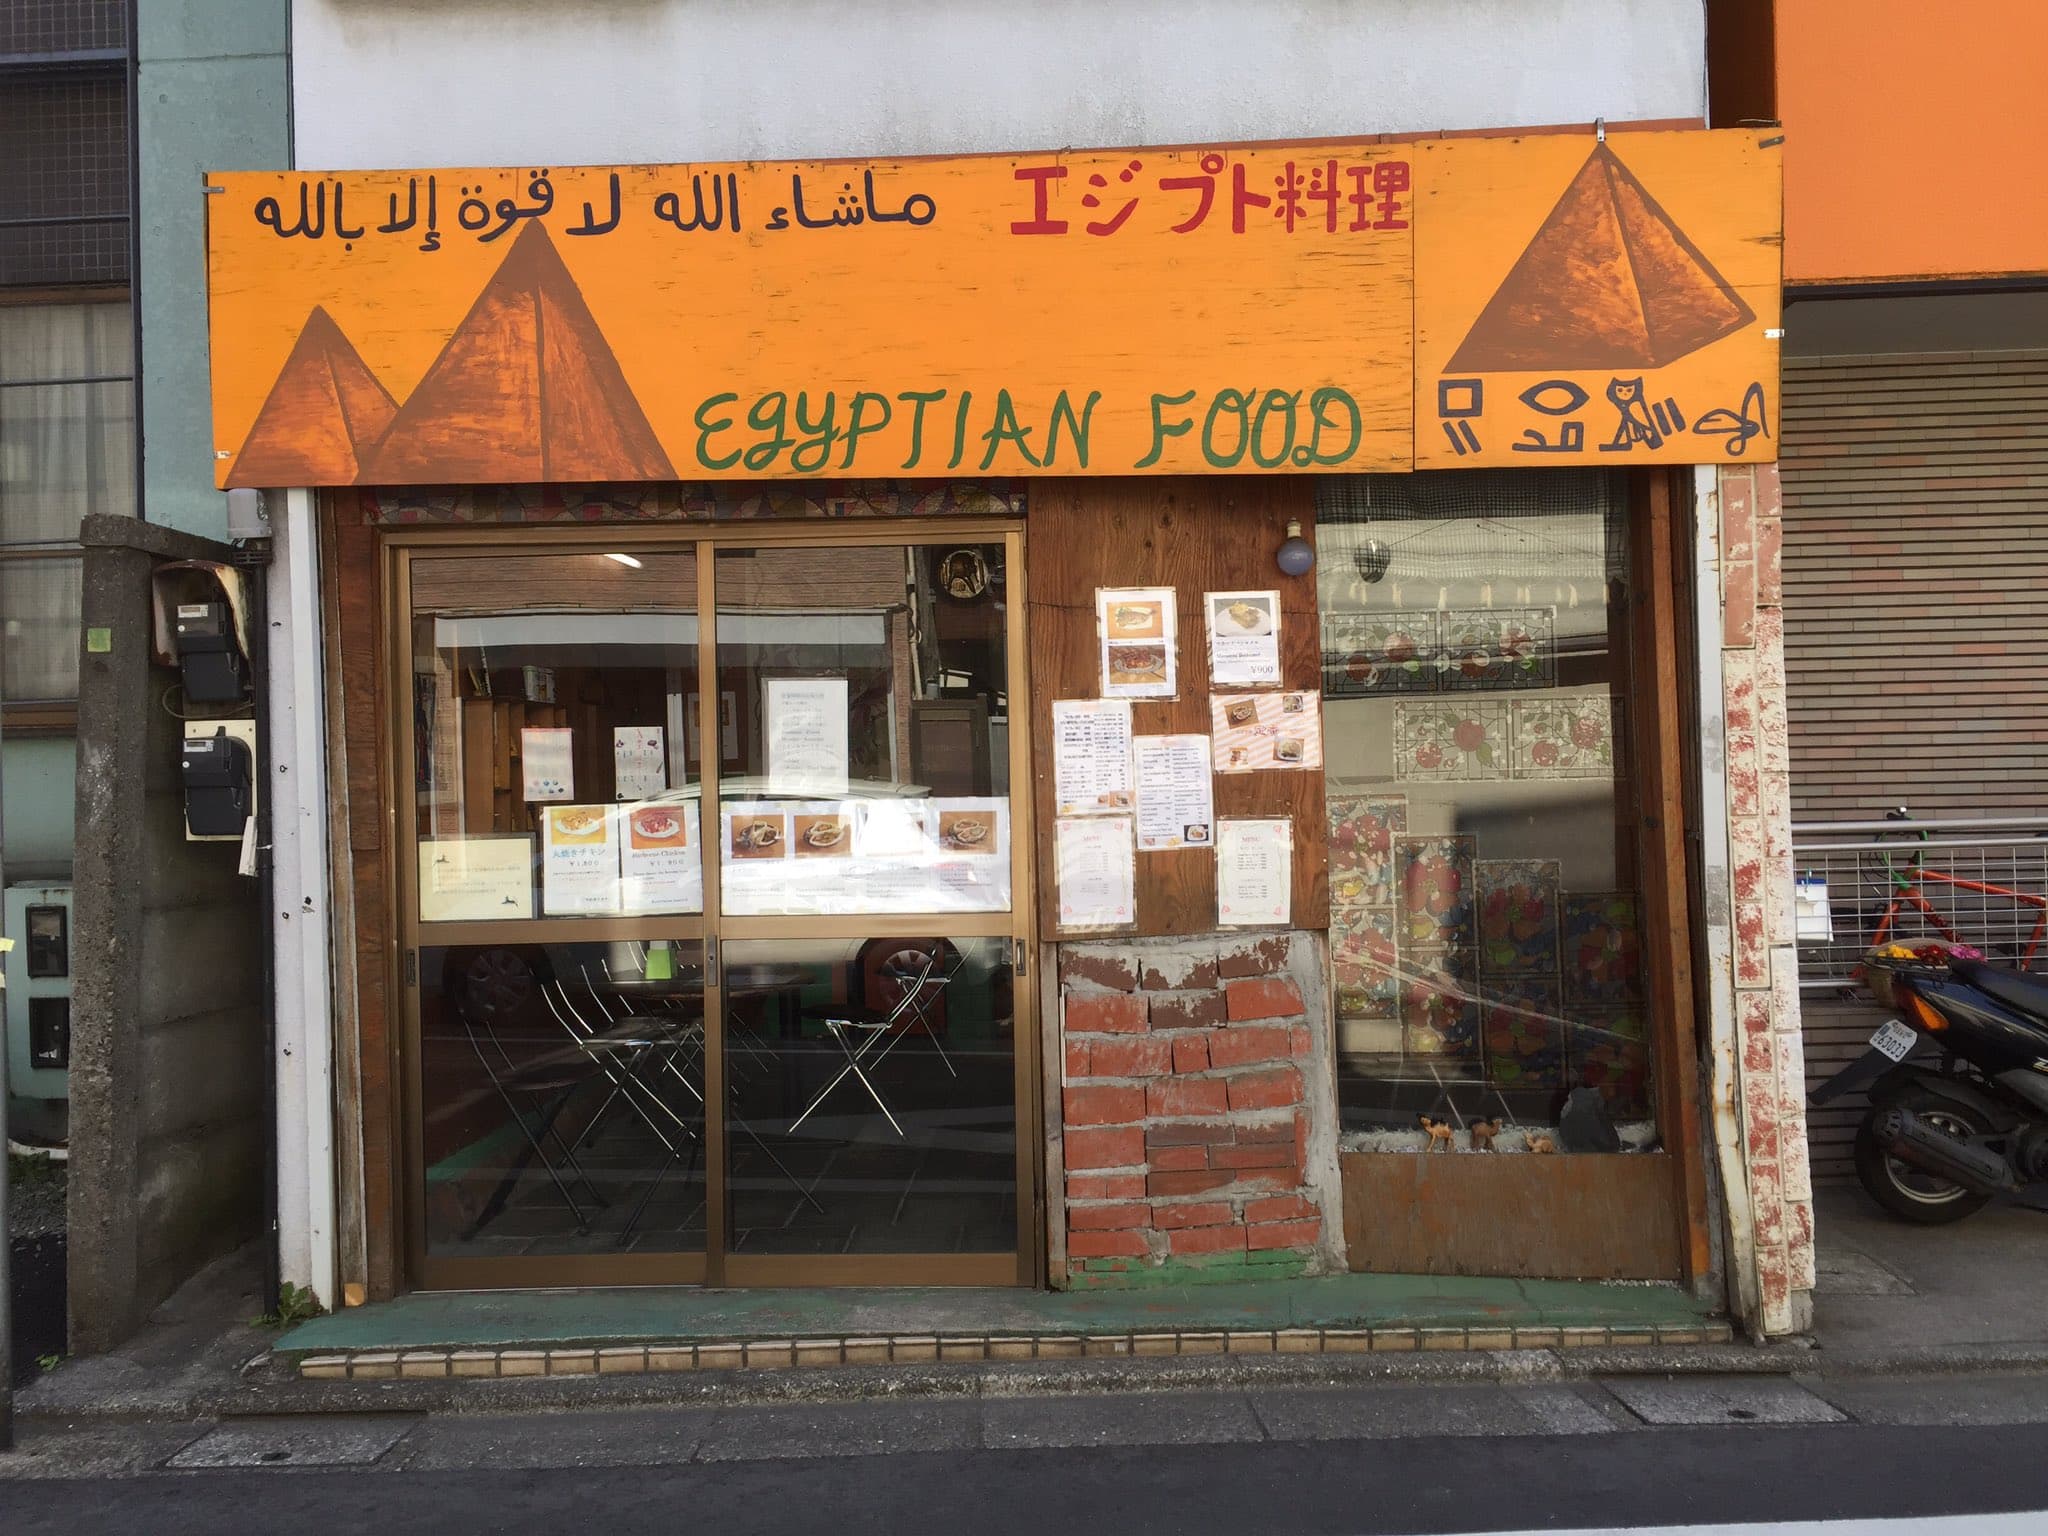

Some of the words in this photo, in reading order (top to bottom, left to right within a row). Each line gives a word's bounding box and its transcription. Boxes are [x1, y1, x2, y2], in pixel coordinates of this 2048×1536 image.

[254, 181, 365, 252] بالله
[376, 174, 440, 252] إلا
[458, 168, 555, 244] قوة
[564, 173, 621, 236] لا
[653, 170, 741, 233] الله
[766, 170, 936, 231] ماشاء
[1010, 153, 1410, 237] エジプト料理
[1133, 386, 1363, 469] FOOD
